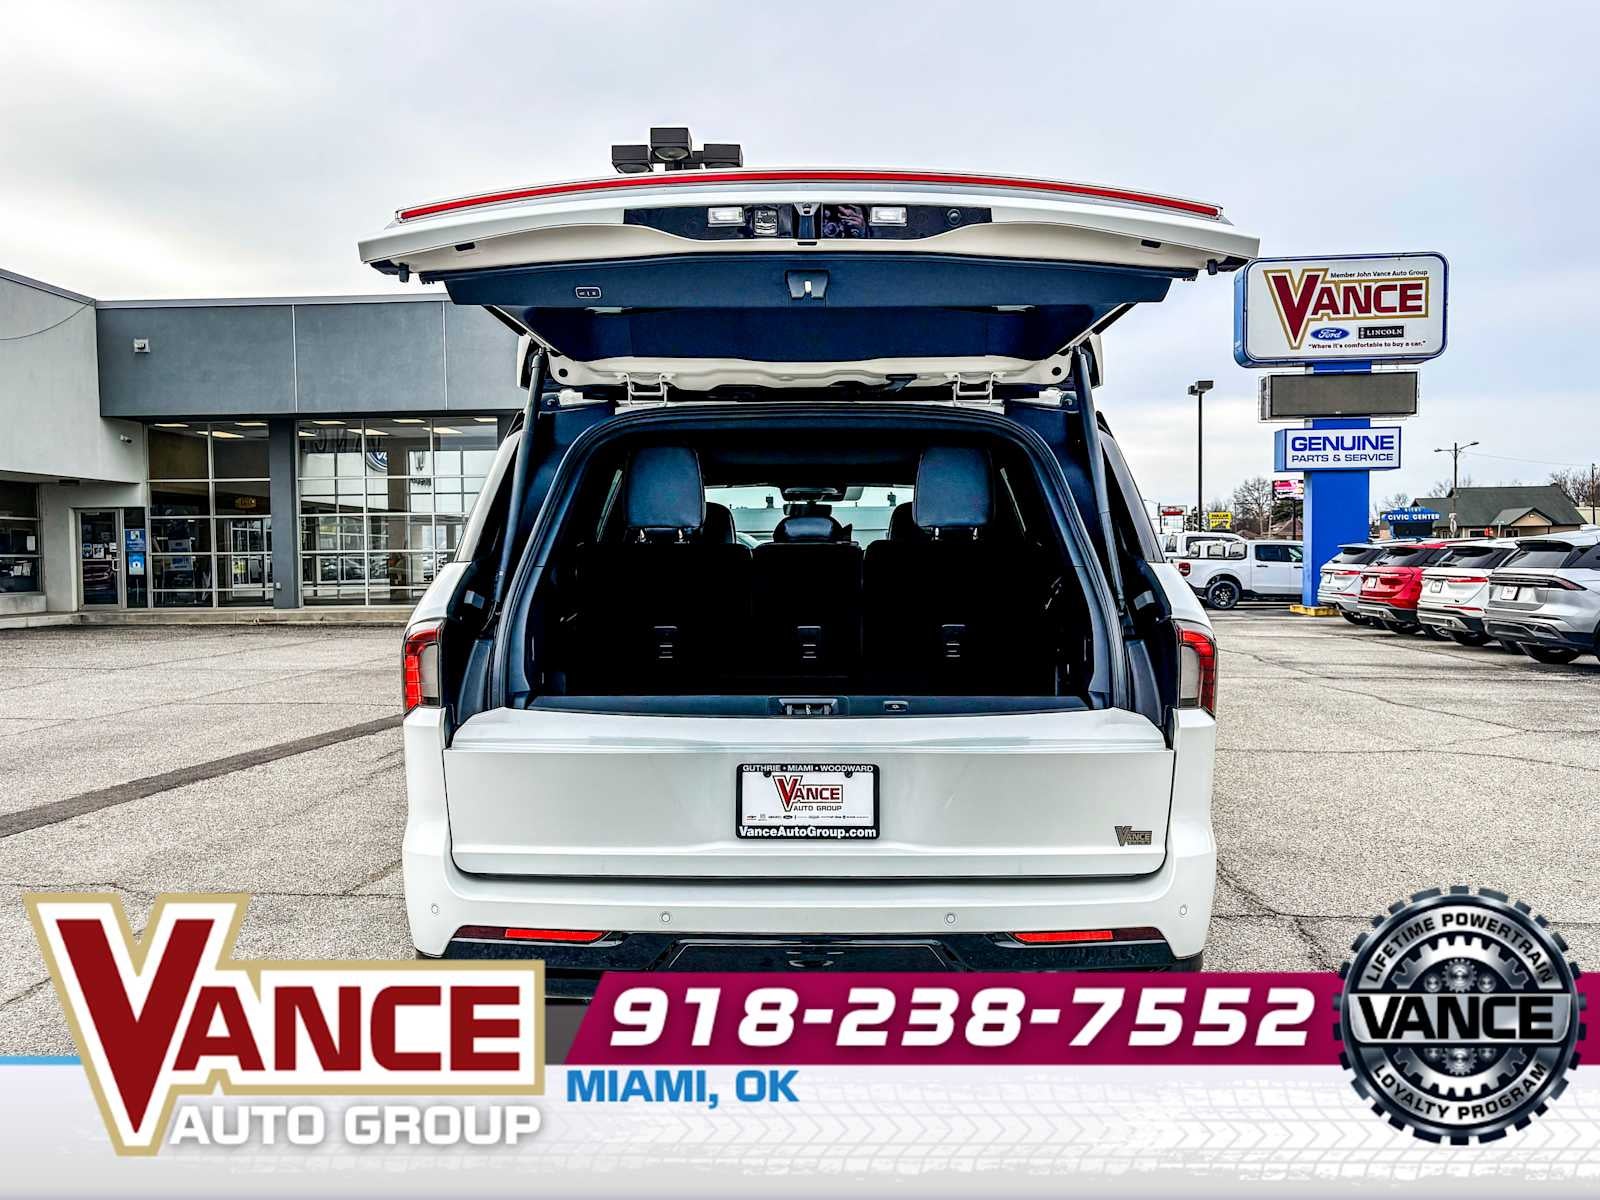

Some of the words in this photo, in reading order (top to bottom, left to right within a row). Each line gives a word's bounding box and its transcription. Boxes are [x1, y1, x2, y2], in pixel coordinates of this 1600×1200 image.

[1408, 269, 1428, 277] Group
[1271, 273, 1424, 344] VANCE
[1318, 329, 1342, 339] Ford
[1366, 328, 1403, 336] LINCOLN
[1392, 341, 1404, 349] buy
[1291, 434, 1395, 452] GENUINE
[1291, 454, 1329, 463] PARTS
[1332, 454, 1341, 462] &
[1344, 453, 1394, 462] SERVICE
[1387, 513, 1410, 521] CIVIC
[1412, 513, 1441, 521] CENTER
[742, 764, 781, 773] GUTHRIE
[787, 764, 814, 773] MIAMI
[819, 764, 874, 773] WOODWARD
[775, 777, 841, 809] VANCE
[738, 826, 877, 839] VanceAutoGroup.com
